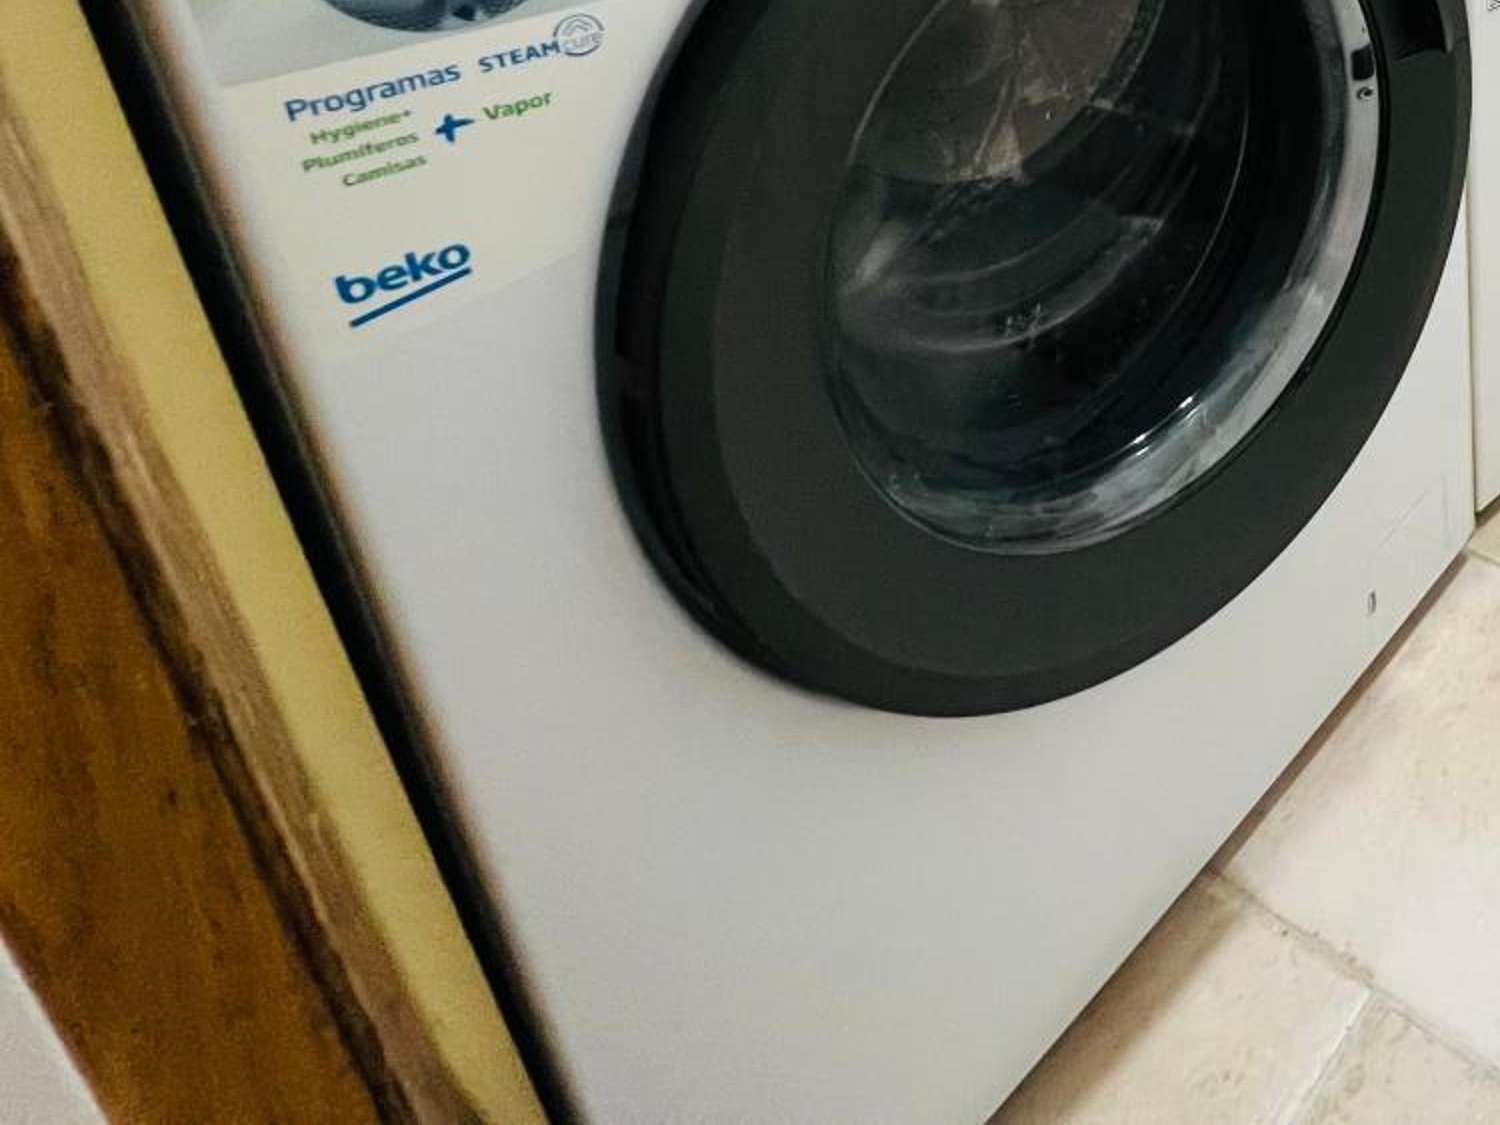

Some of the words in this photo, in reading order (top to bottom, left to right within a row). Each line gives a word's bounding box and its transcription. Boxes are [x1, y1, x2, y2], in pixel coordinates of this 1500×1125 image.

[284, 64, 462, 122] Programas
[477, 39, 561, 74] STEAM
[482, 91, 553, 122] Vapor
[341, 153, 427, 187] Camisas
[335, 243, 470, 304] beko
